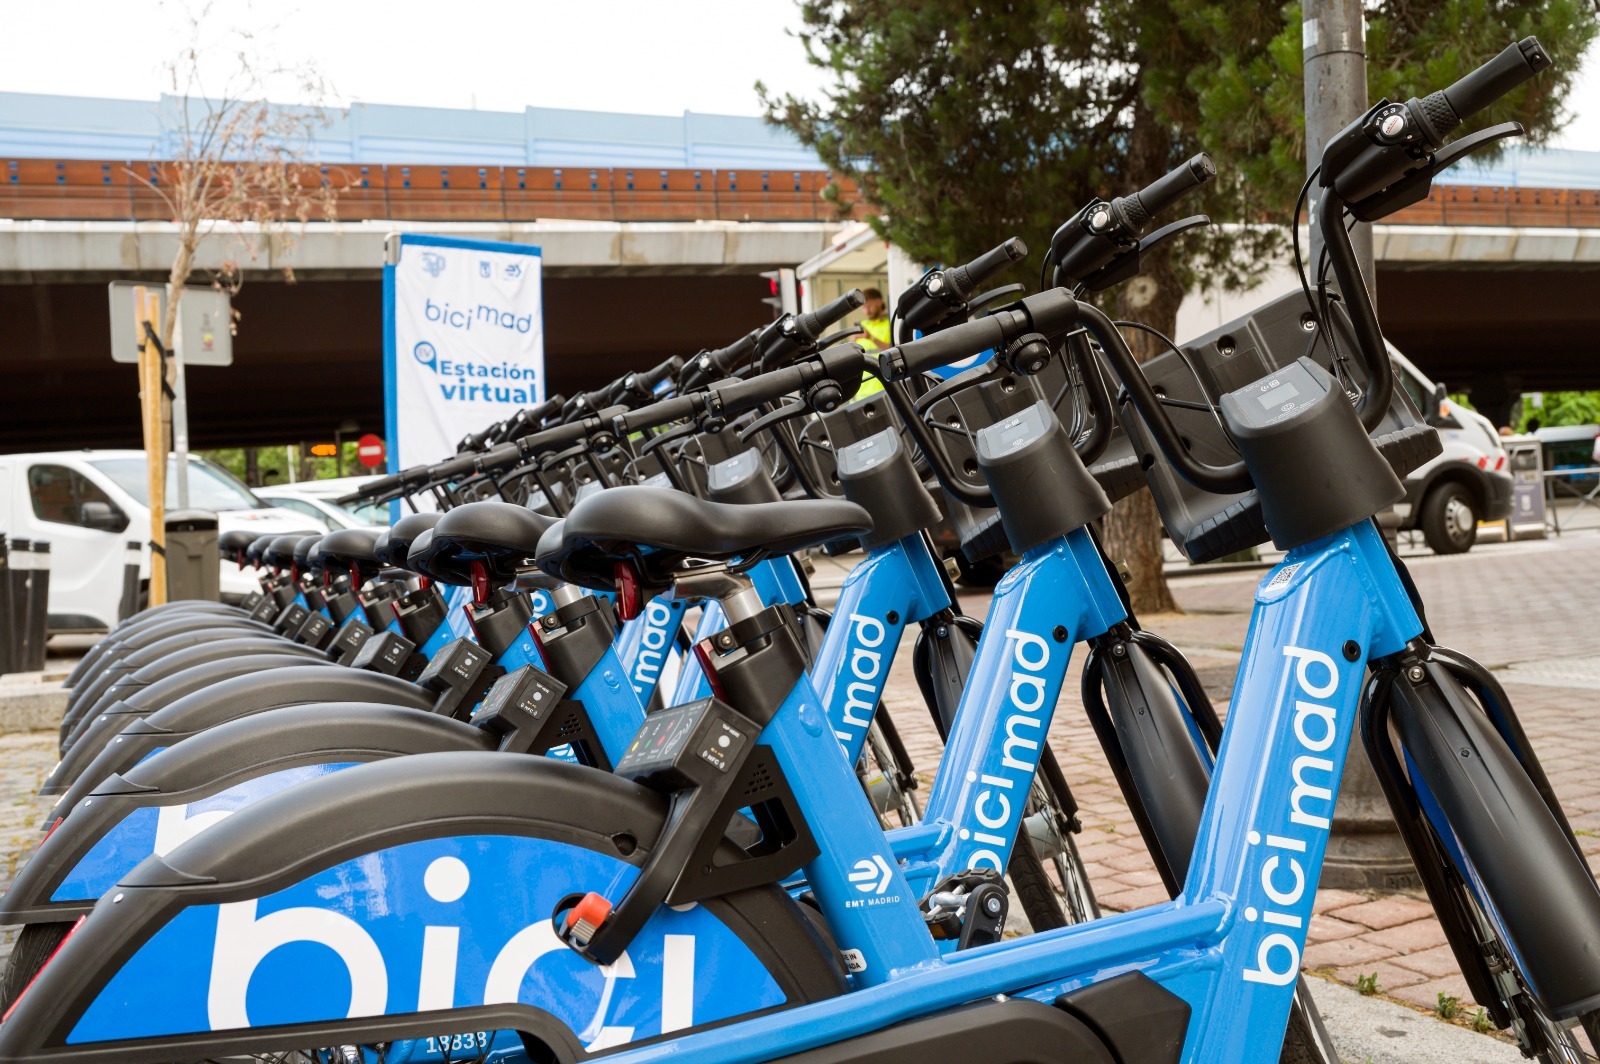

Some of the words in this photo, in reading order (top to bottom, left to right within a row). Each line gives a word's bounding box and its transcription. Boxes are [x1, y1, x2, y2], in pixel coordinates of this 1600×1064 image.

[440, 360, 536, 380] Estación
[440, 378, 537, 403] virtual
[707, 754, 719, 765] NFC
[845, 899, 865, 908] EMT
[868, 895, 900, 906] MADRID
[425, 1031, 487, 1054] 18838
